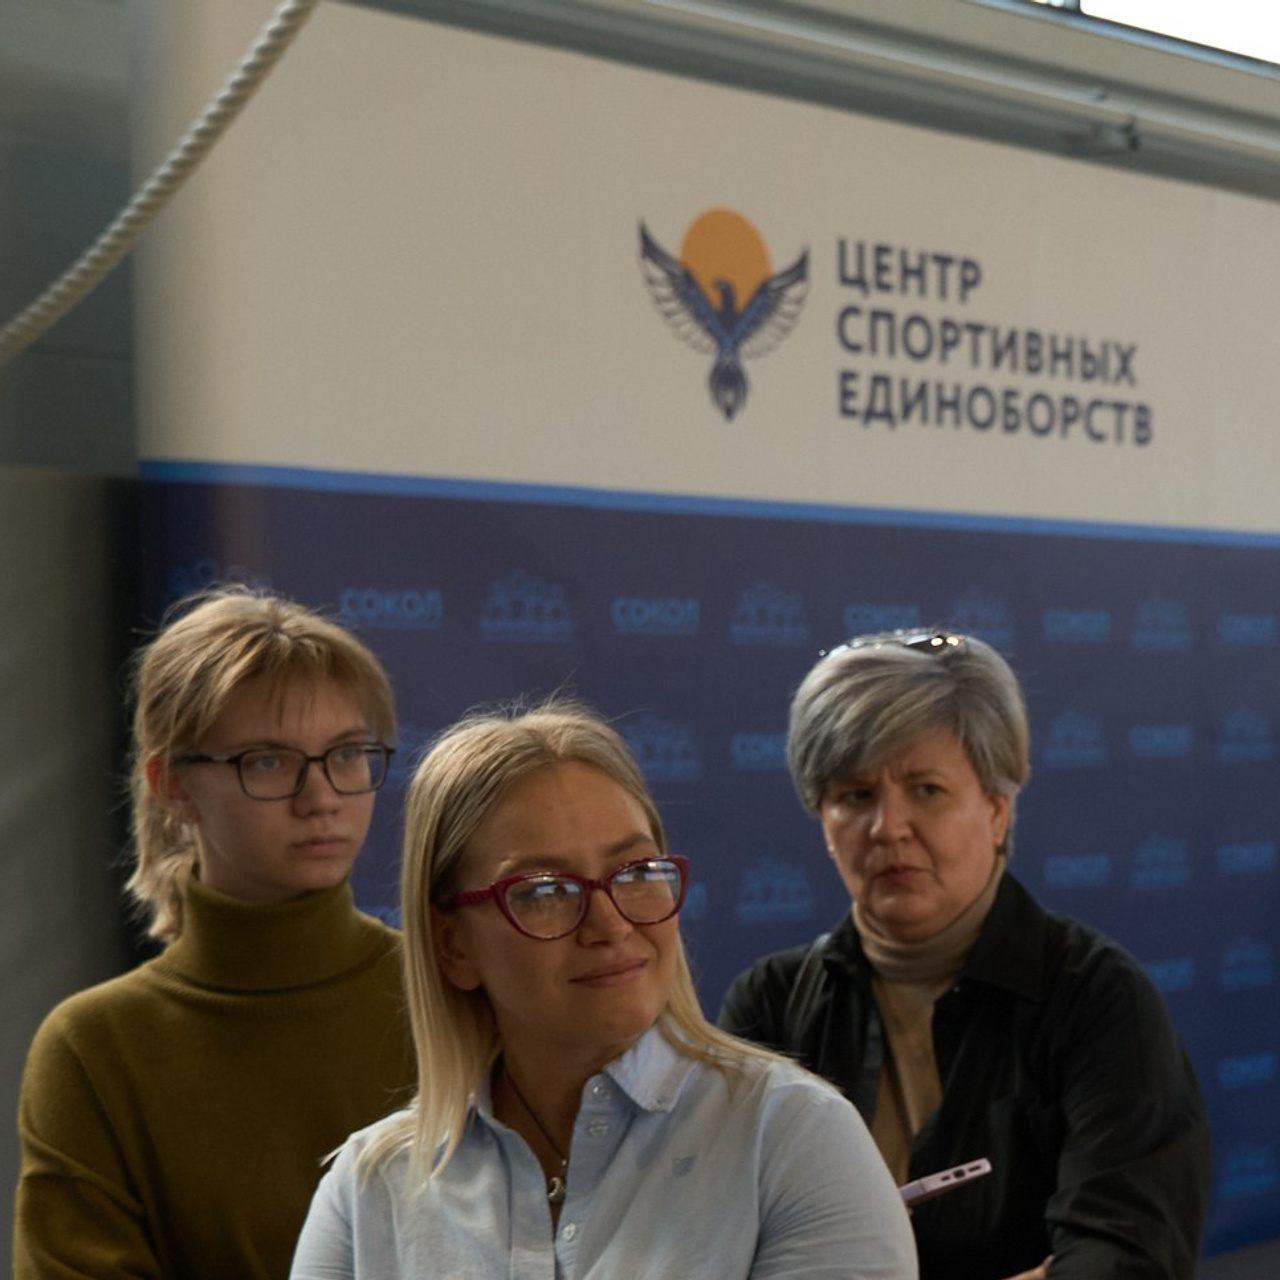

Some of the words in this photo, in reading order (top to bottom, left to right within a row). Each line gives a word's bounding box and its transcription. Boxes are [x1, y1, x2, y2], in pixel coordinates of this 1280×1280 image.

[838, 237, 982, 304] ЦЕНТР
[837, 305, 1138, 387] СПОРТИВНЫХ
[838, 370, 1154, 447] ЕДИНОБОРСТВ
[339, 588, 443, 622] СОКОЛ
[610, 597, 703, 626] СОКОЛ
